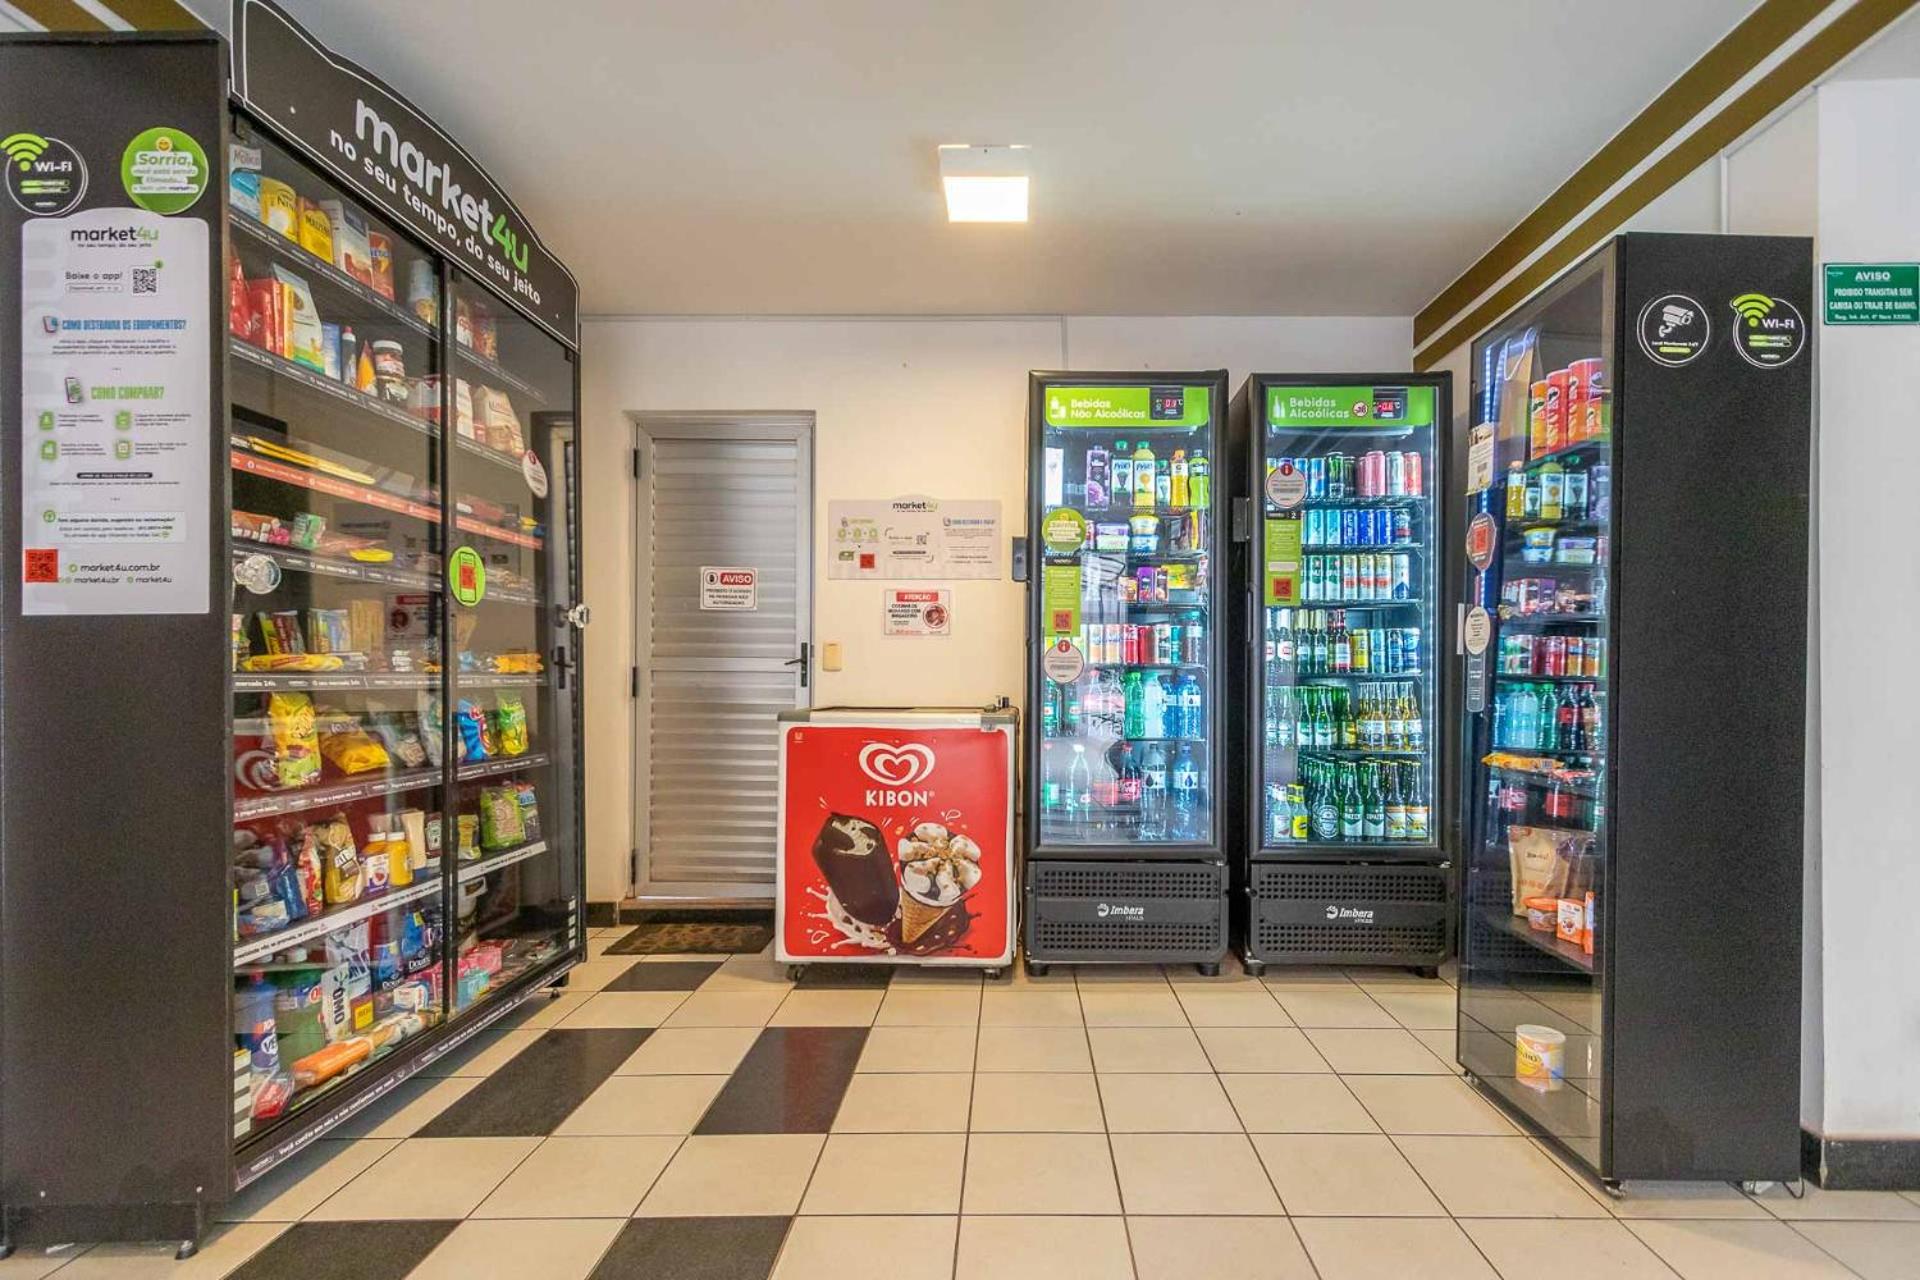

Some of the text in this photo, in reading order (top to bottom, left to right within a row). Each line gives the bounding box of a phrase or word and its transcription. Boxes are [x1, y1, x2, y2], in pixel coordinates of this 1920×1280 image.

[138, 153, 191, 167] Sorria,
[355, 98, 529, 273] market4u
[330, 129, 541, 305] no seu tempo, do seu jeito
[71, 226, 159, 240] market4u
[1855, 271, 1891, 281] AVISO
[91, 386, 117, 400] COMO
[1070, 398, 1110, 409] Bebidas
[1289, 397, 1336, 408] Bebidas
[1070, 408, 1092, 418] Não
[1289, 408, 1350, 418] Alcoólicas
[722, 575, 752, 583] AVISO
[866, 790, 928, 807] KIBON
[332, 987, 345, 1025] OMO
